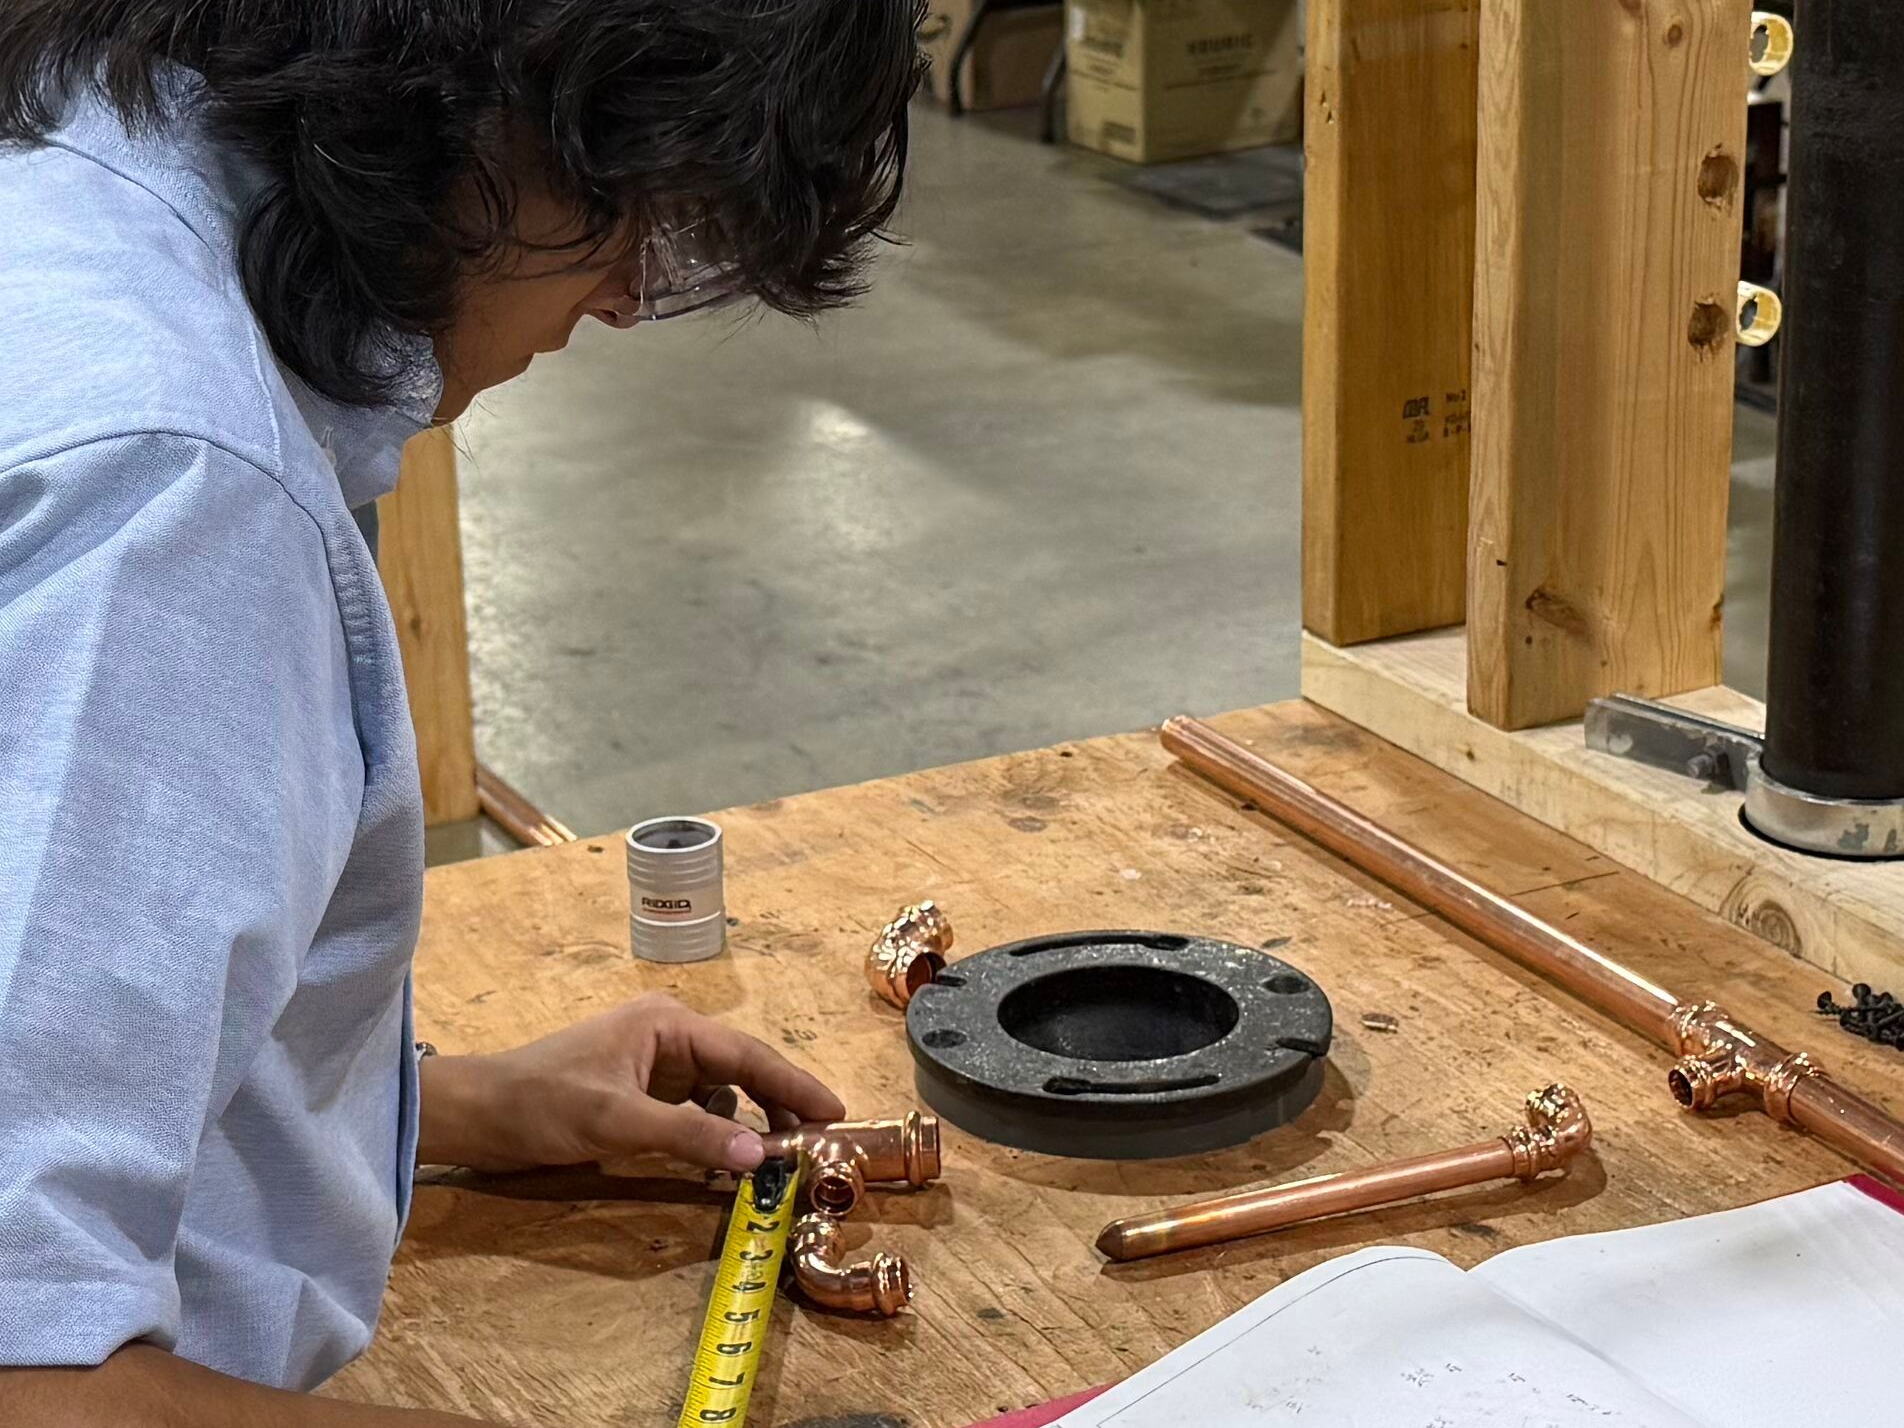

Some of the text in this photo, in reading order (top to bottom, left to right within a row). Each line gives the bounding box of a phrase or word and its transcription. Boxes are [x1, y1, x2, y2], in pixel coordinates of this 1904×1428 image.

[747, 1221, 780, 1233] 2
[739, 1249, 773, 1262] 3
[732, 1280, 766, 1292] 4
[724, 1308, 760, 1323] 5
[716, 1341, 752, 1355] 6
[708, 1371, 745, 1386] 7
[699, 1406, 737, 1421] 8
